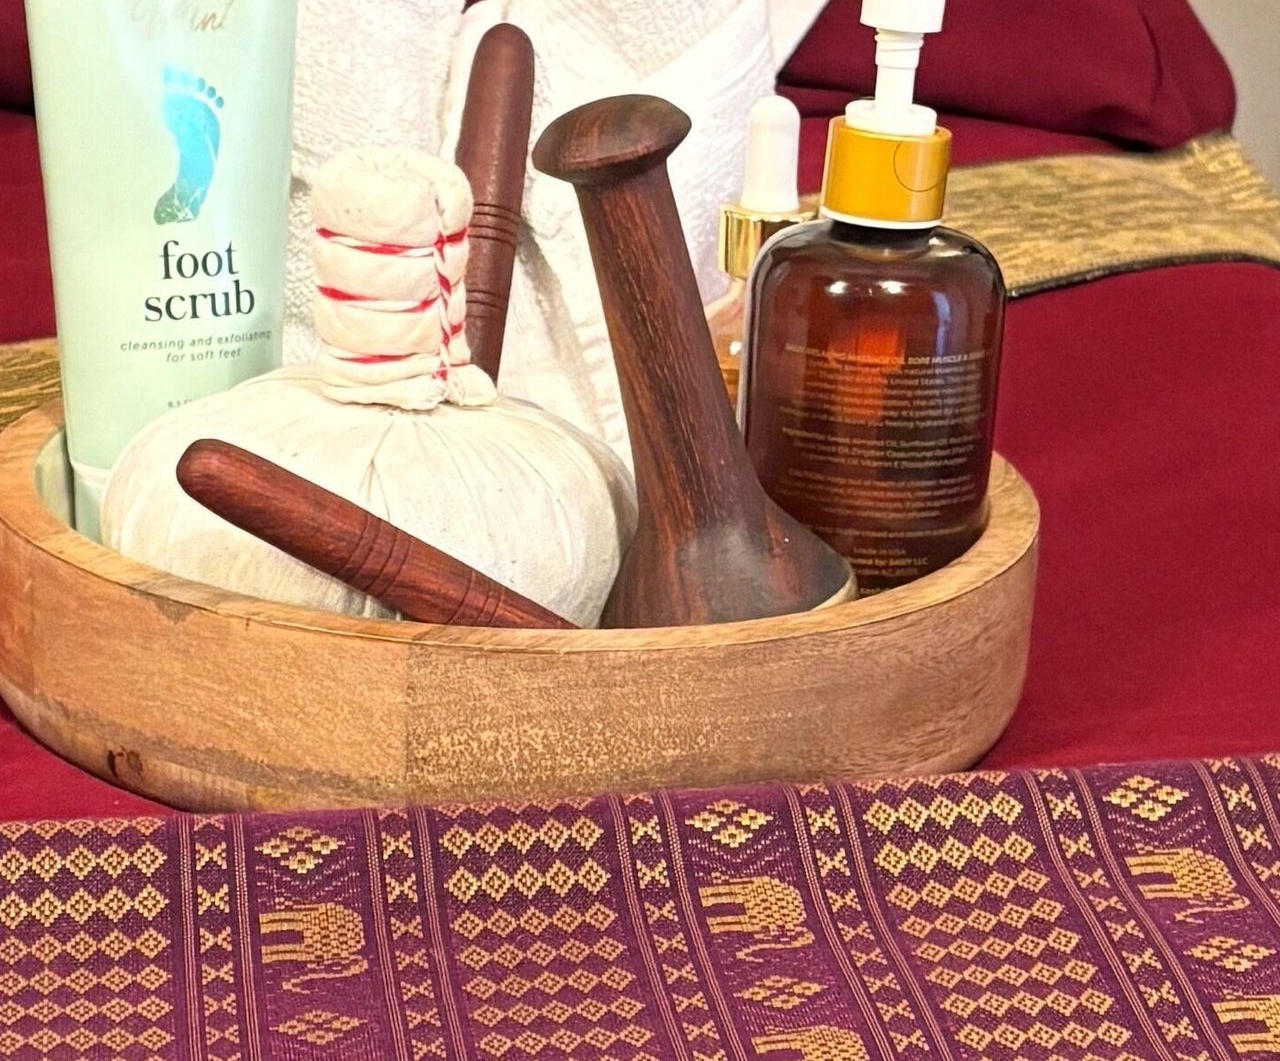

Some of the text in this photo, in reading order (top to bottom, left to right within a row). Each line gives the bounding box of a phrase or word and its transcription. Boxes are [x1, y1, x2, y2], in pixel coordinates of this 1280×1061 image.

[159, 239, 239, 280] foot
[144, 279, 255, 322] scrub
[120, 330, 271, 351] cleansing and exfoliating
[166, 347, 241, 363] for soft feet
